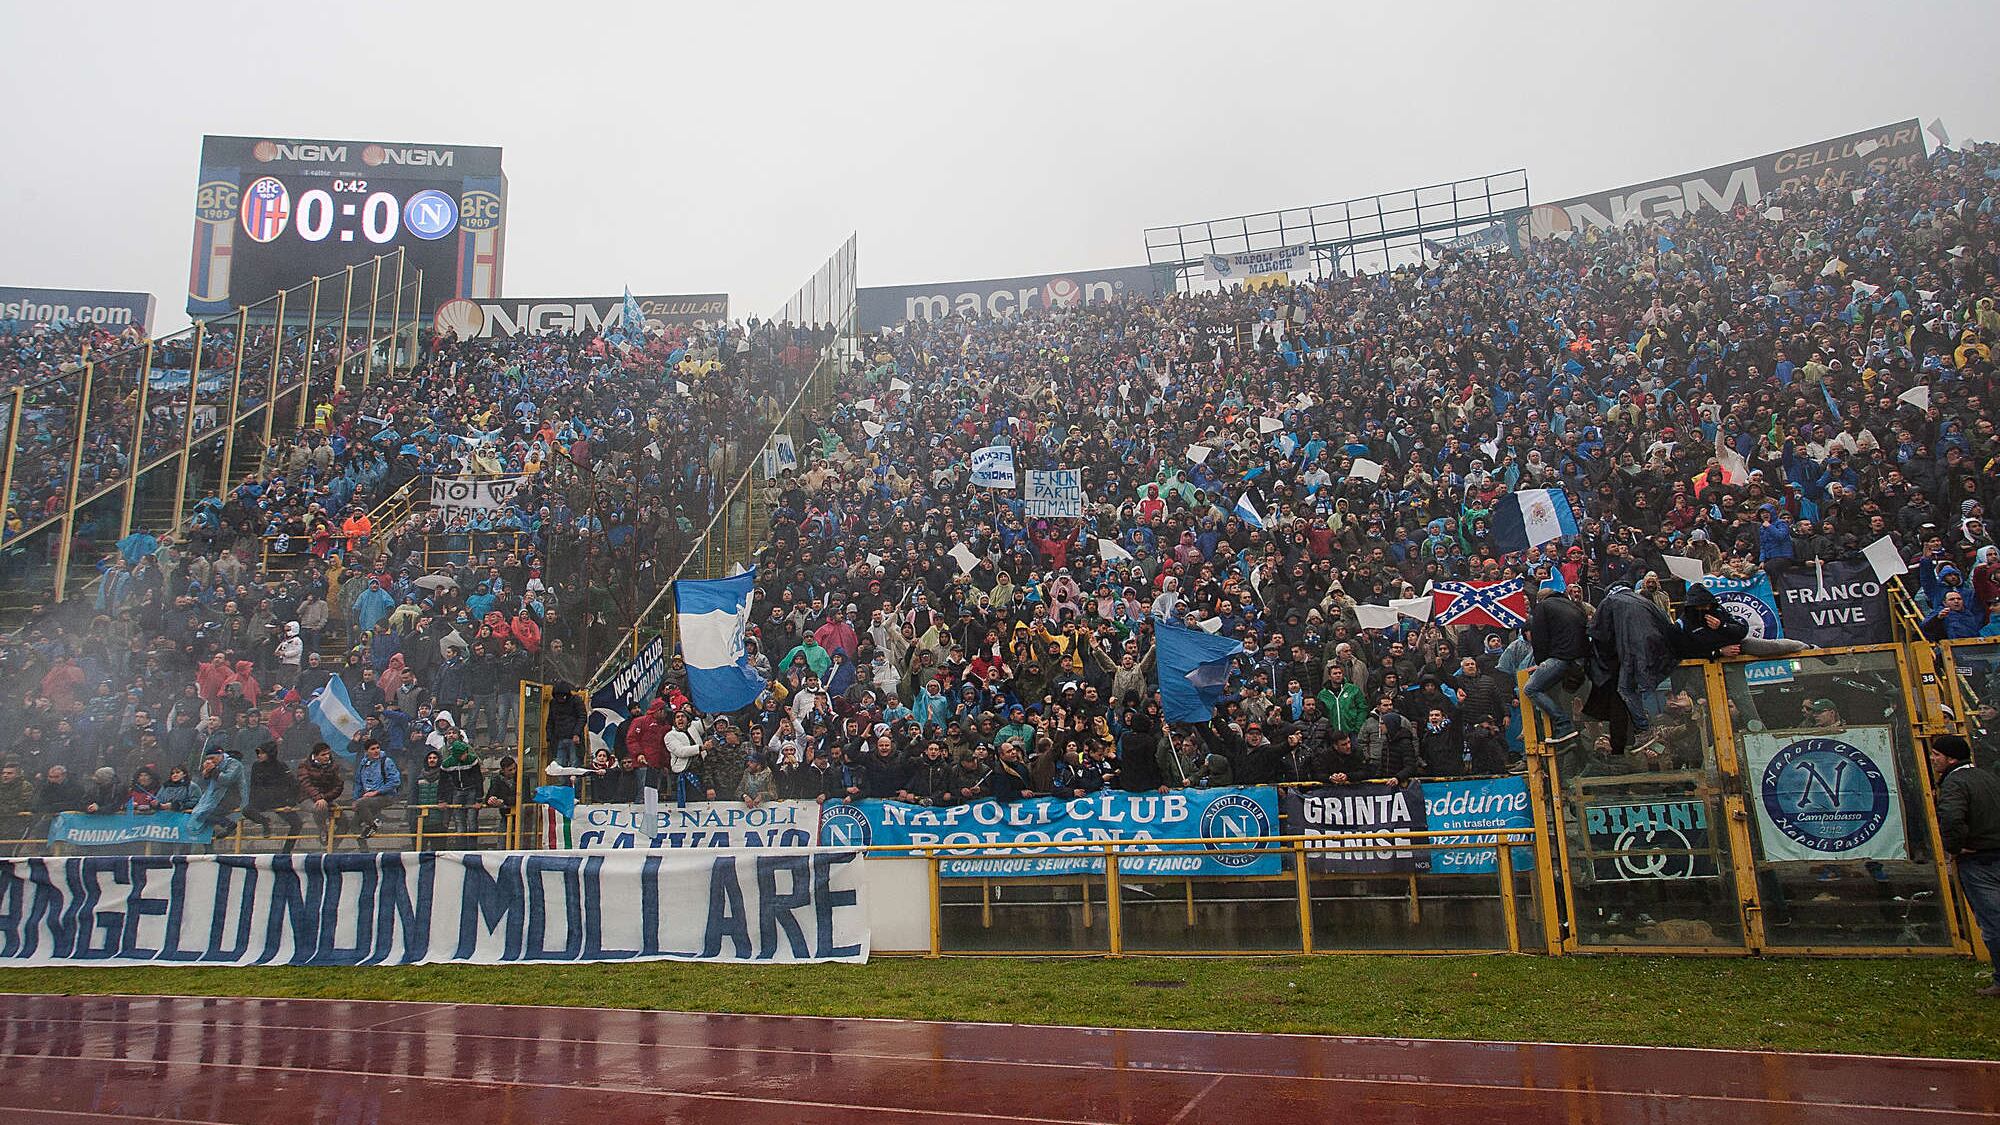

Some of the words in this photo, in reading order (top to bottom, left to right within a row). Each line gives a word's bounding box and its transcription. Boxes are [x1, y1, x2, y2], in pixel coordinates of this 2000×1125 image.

[275, 144, 347, 162] NGM
[383, 148, 454, 167] NGM
[1775, 127, 1919, 174] CELLUARI
[256, 180, 280, 193] BFC
[333, 179, 368, 193] 0:42
[198, 187, 239, 210] BFC
[461, 195, 499, 219] BFC
[1564, 166, 1762, 236] NGM
[204, 209, 230, 219] 1909
[296, 189, 400, 244] 0:0
[418, 203, 443, 227] N
[465, 218, 490, 227] 1909
[1444, 233, 1484, 249] PARMA
[1234, 252, 1274, 266] NAPOLI
[1279, 245, 1305, 259] CLUB
[1248, 258, 1294, 274] MARCHE
[0, 299, 132, 325] shop.com
[637, 300, 728, 316] CELLULARI
[482, 303, 624, 338] NGM
[1049, 470, 1077, 486] NON
[1035, 486, 1080, 500] PARTO
[1785, 581, 1880, 604] FRANCO
[1809, 606, 1866, 626] VIVE
[613, 656, 644, 700] NAPOLI
[643, 637, 663, 671] CLUB
[1922, 674, 1935, 682] 38
[1765, 739, 1824, 787] Napoli
[1832, 743, 1882, 780] Club
[1795, 760, 1848, 808] N
[587, 809, 672, 829] CLUB
[679, 806, 799, 828] NAPOLI
[820, 807, 845, 823] APOLI
[848, 809, 866, 828] CLUB
[881, 800, 1051, 826] NAPOLI
[1066, 795, 1189, 823] CLUB
[1206, 797, 1236, 820] NAPOLI
[1241, 799, 1264, 820] CLUB
[1304, 792, 1411, 826] GRINTA
[1585, 802, 1708, 835] RIMINI
[1796, 809, 1863, 825] Campobasso
[68, 828, 117, 842] RIMINI
[1220, 815, 1249, 847] N
[1452, 820, 1461, 829] in
[1463, 818, 1506, 828] trasferta
[1774, 817, 1829, 850] Napoli
[908, 827, 1162, 857] BOLOGNA
[1303, 827, 1413, 861] DENISE
[939, 860, 947, 873] E
[951, 858, 1032, 873] COMUNQUE
[1036, 857, 1089, 871] SEMPRE
[1147, 857, 1202, 872] FIANCO
[250, 853, 440, 966] NON
[452, 852, 862, 961] MOLLARE
